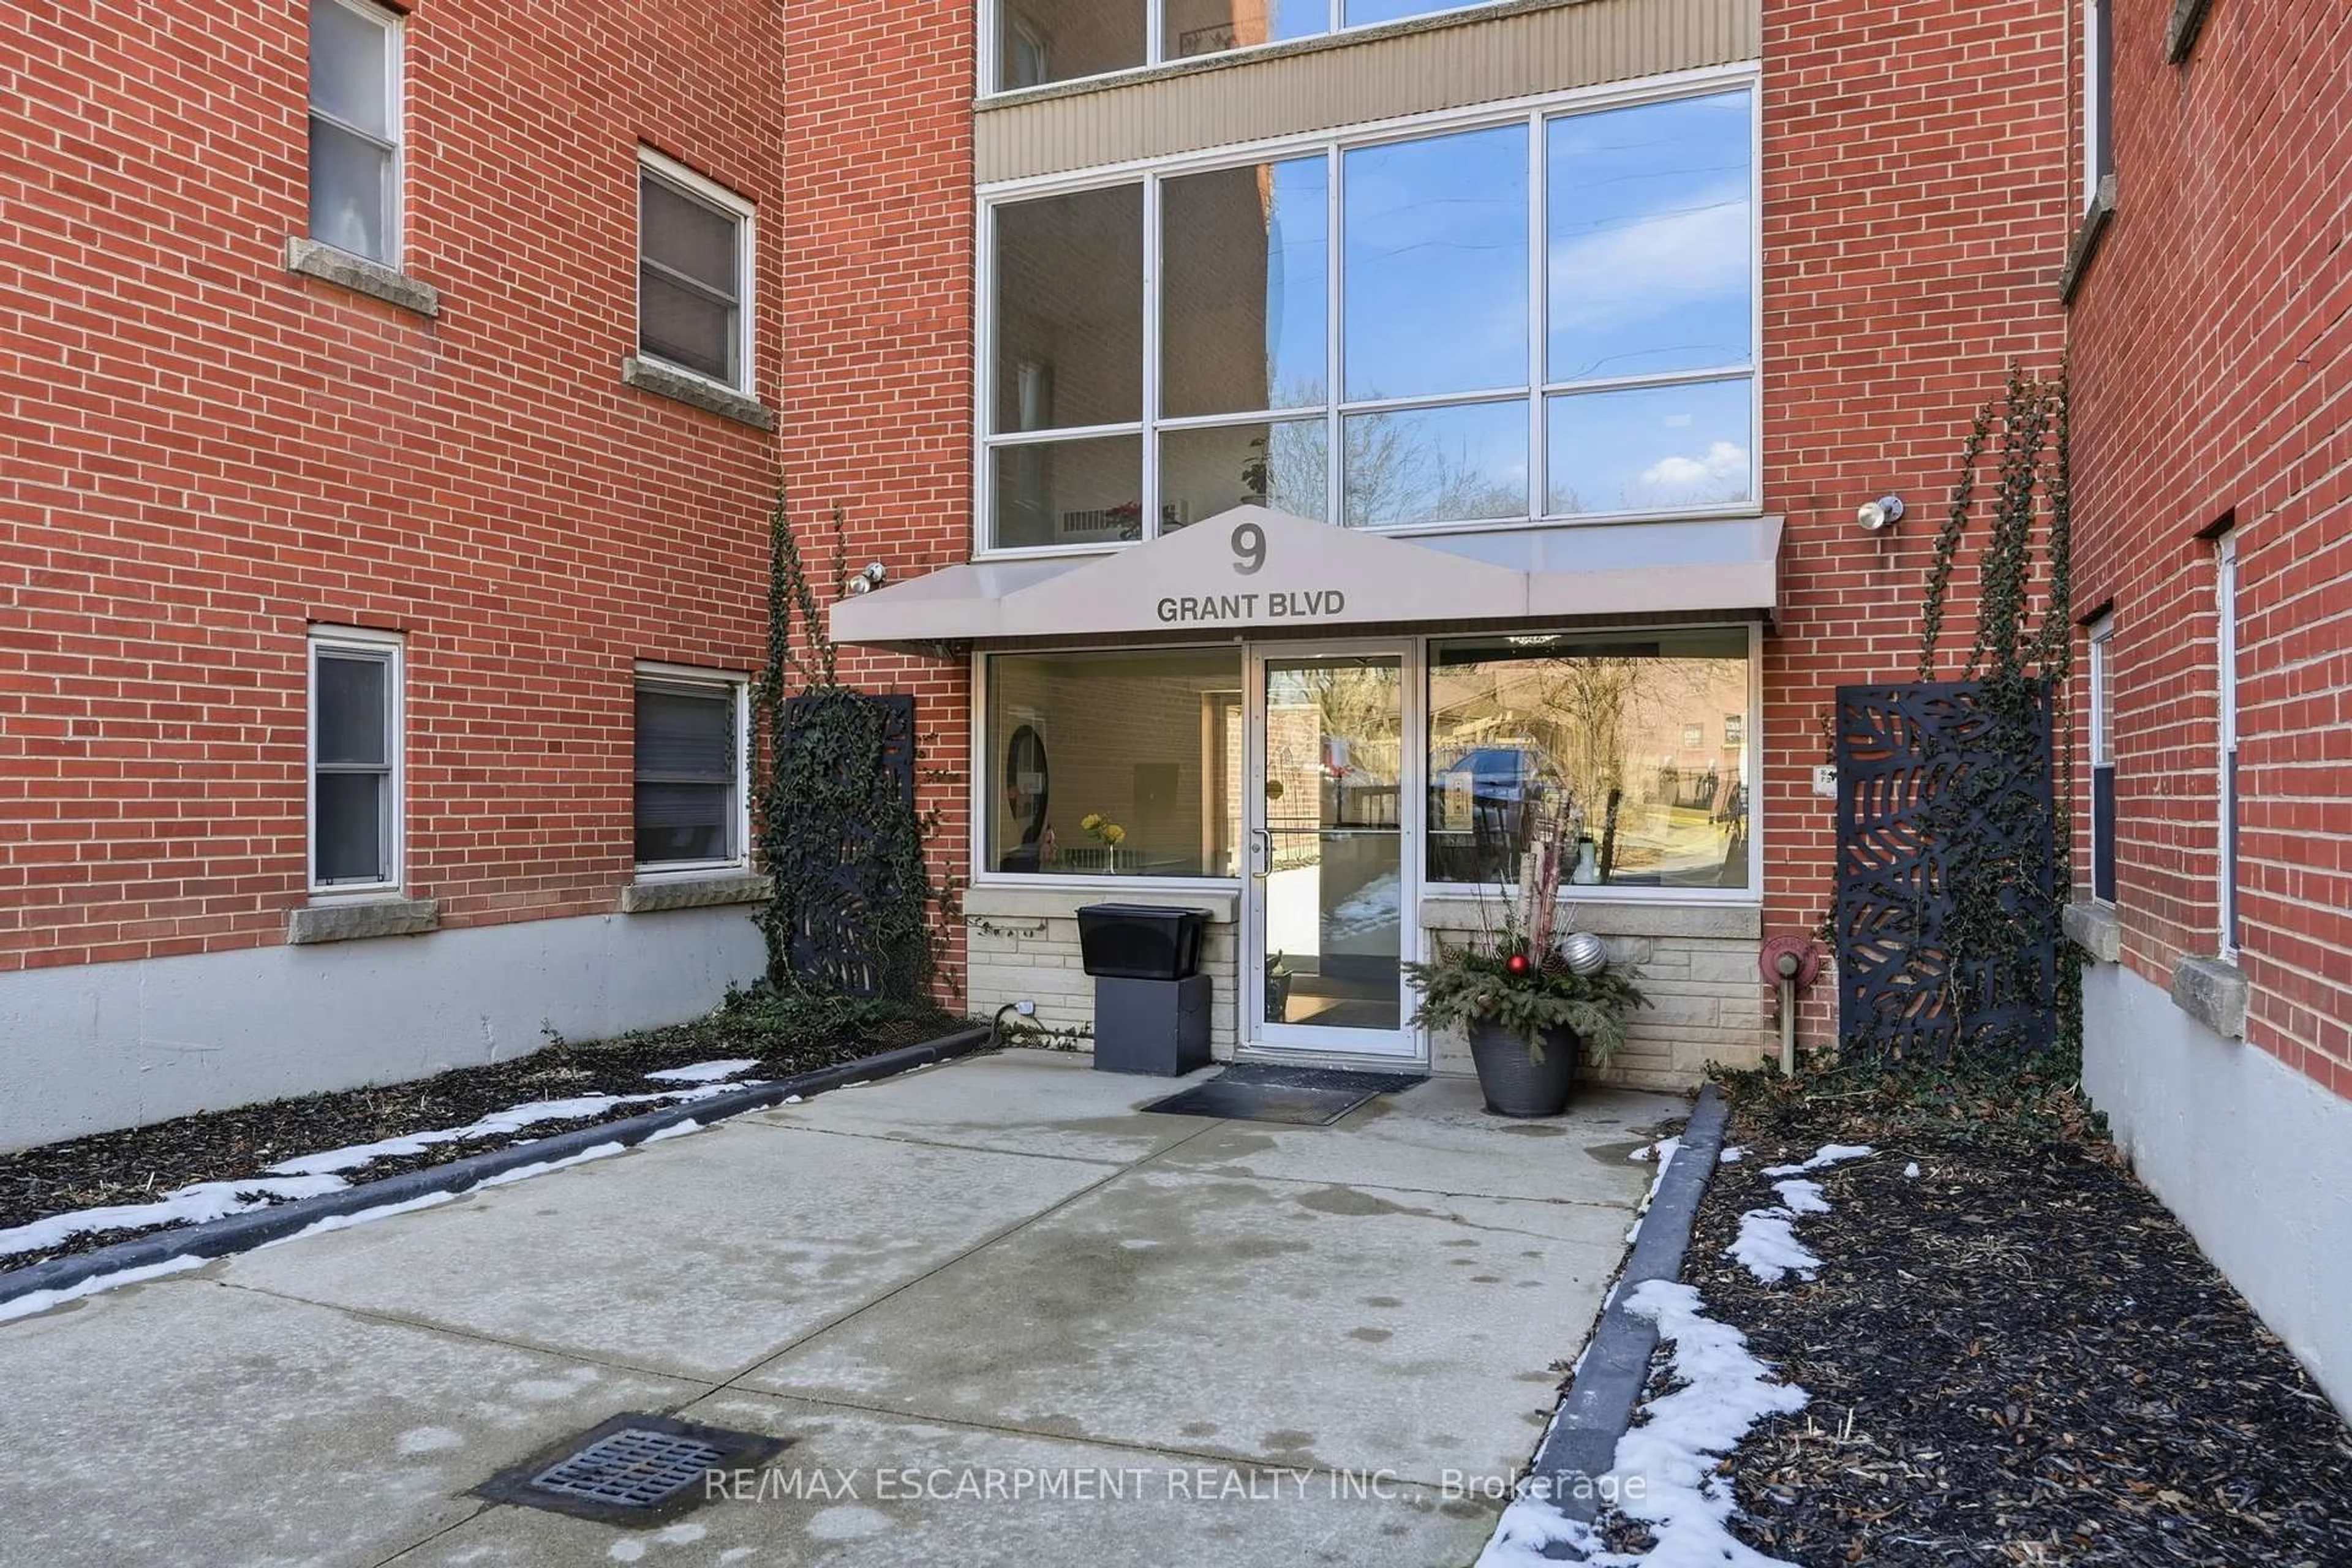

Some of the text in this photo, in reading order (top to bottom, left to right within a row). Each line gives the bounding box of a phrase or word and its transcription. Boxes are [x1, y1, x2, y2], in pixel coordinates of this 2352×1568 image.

[1231, 522, 1267, 576] 9
[1157, 590, 1345, 622] GRANT BLVD
